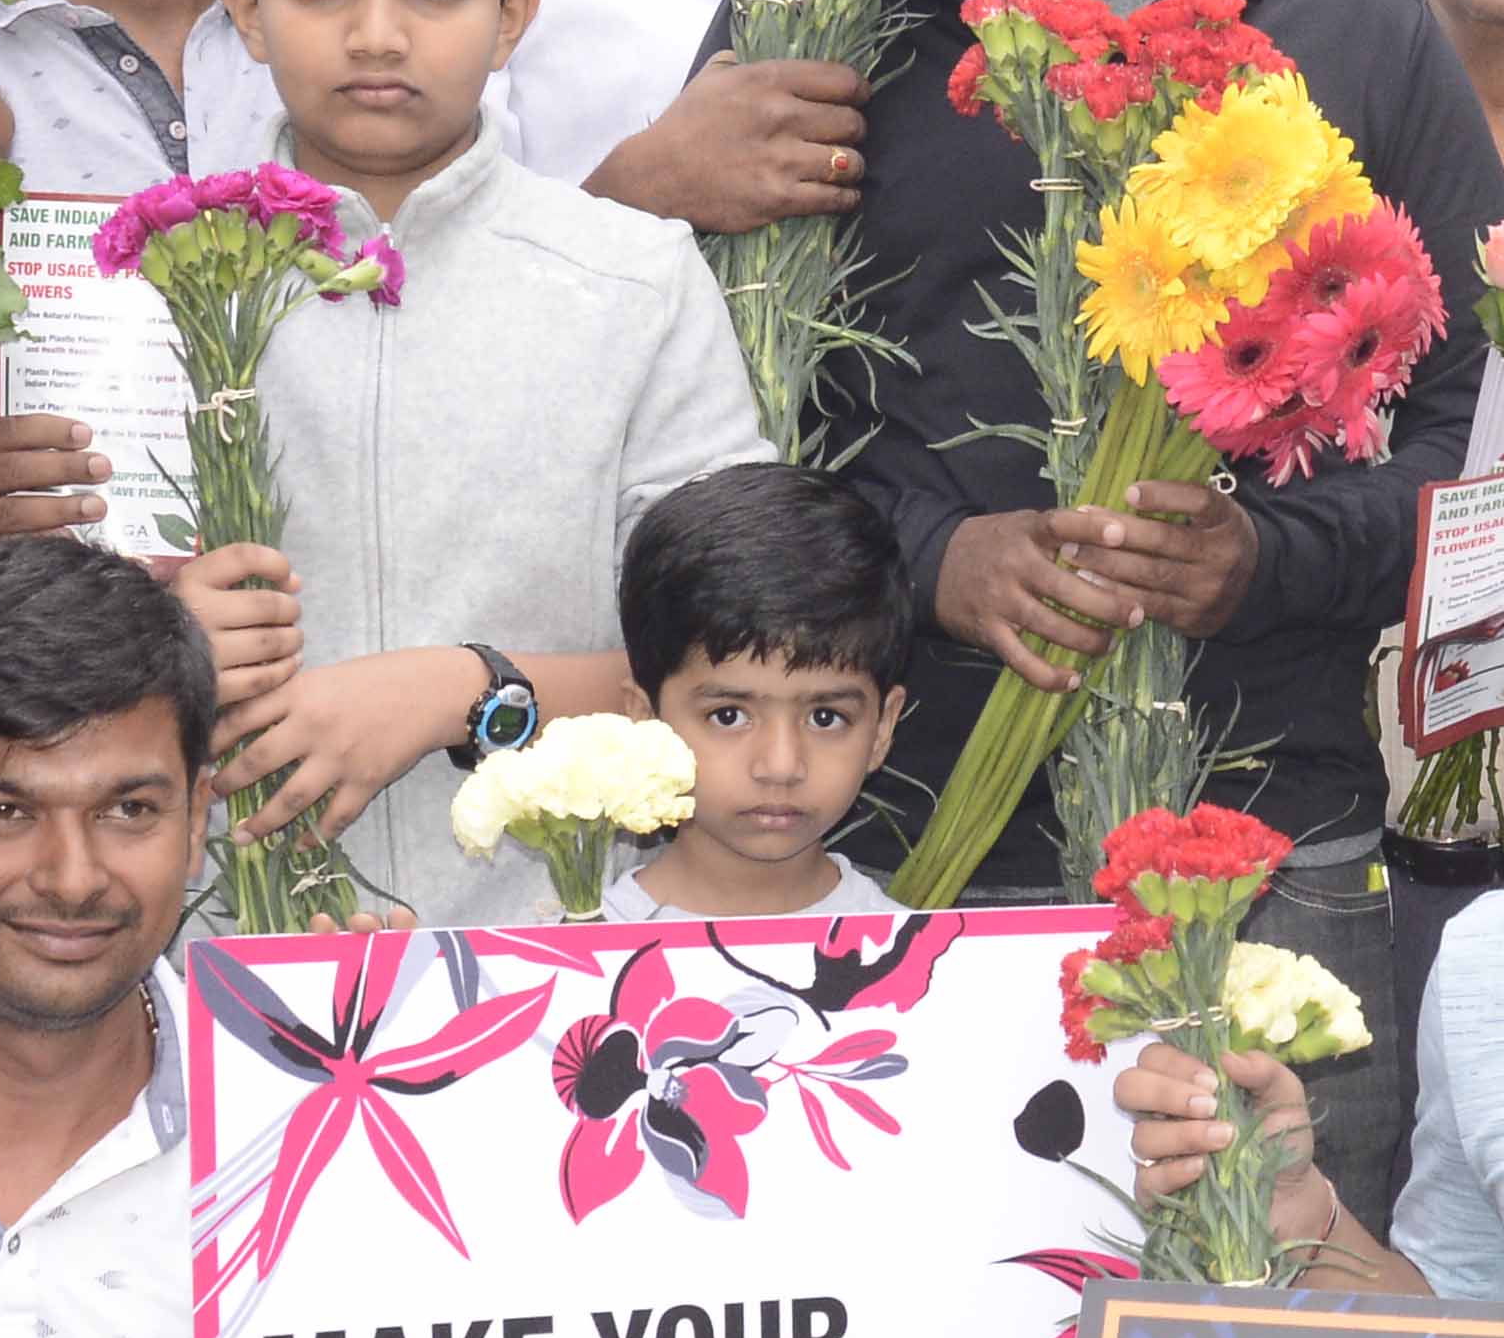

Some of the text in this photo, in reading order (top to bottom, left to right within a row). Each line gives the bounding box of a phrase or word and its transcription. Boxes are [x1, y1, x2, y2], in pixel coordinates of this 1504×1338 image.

[10, 207, 49, 223] SAVE
[9, 232, 41, 248] AND
[7, 262, 42, 277] STOP
[47, 263, 96, 278] USAGE
[21, 284, 73, 299] OWERS
[1439, 488, 1478, 505] SAVE
[1438, 506, 1470, 522] AND
[1434, 525, 1470, 541] STOP
[1433, 533, 1497, 556] FLOWERS
